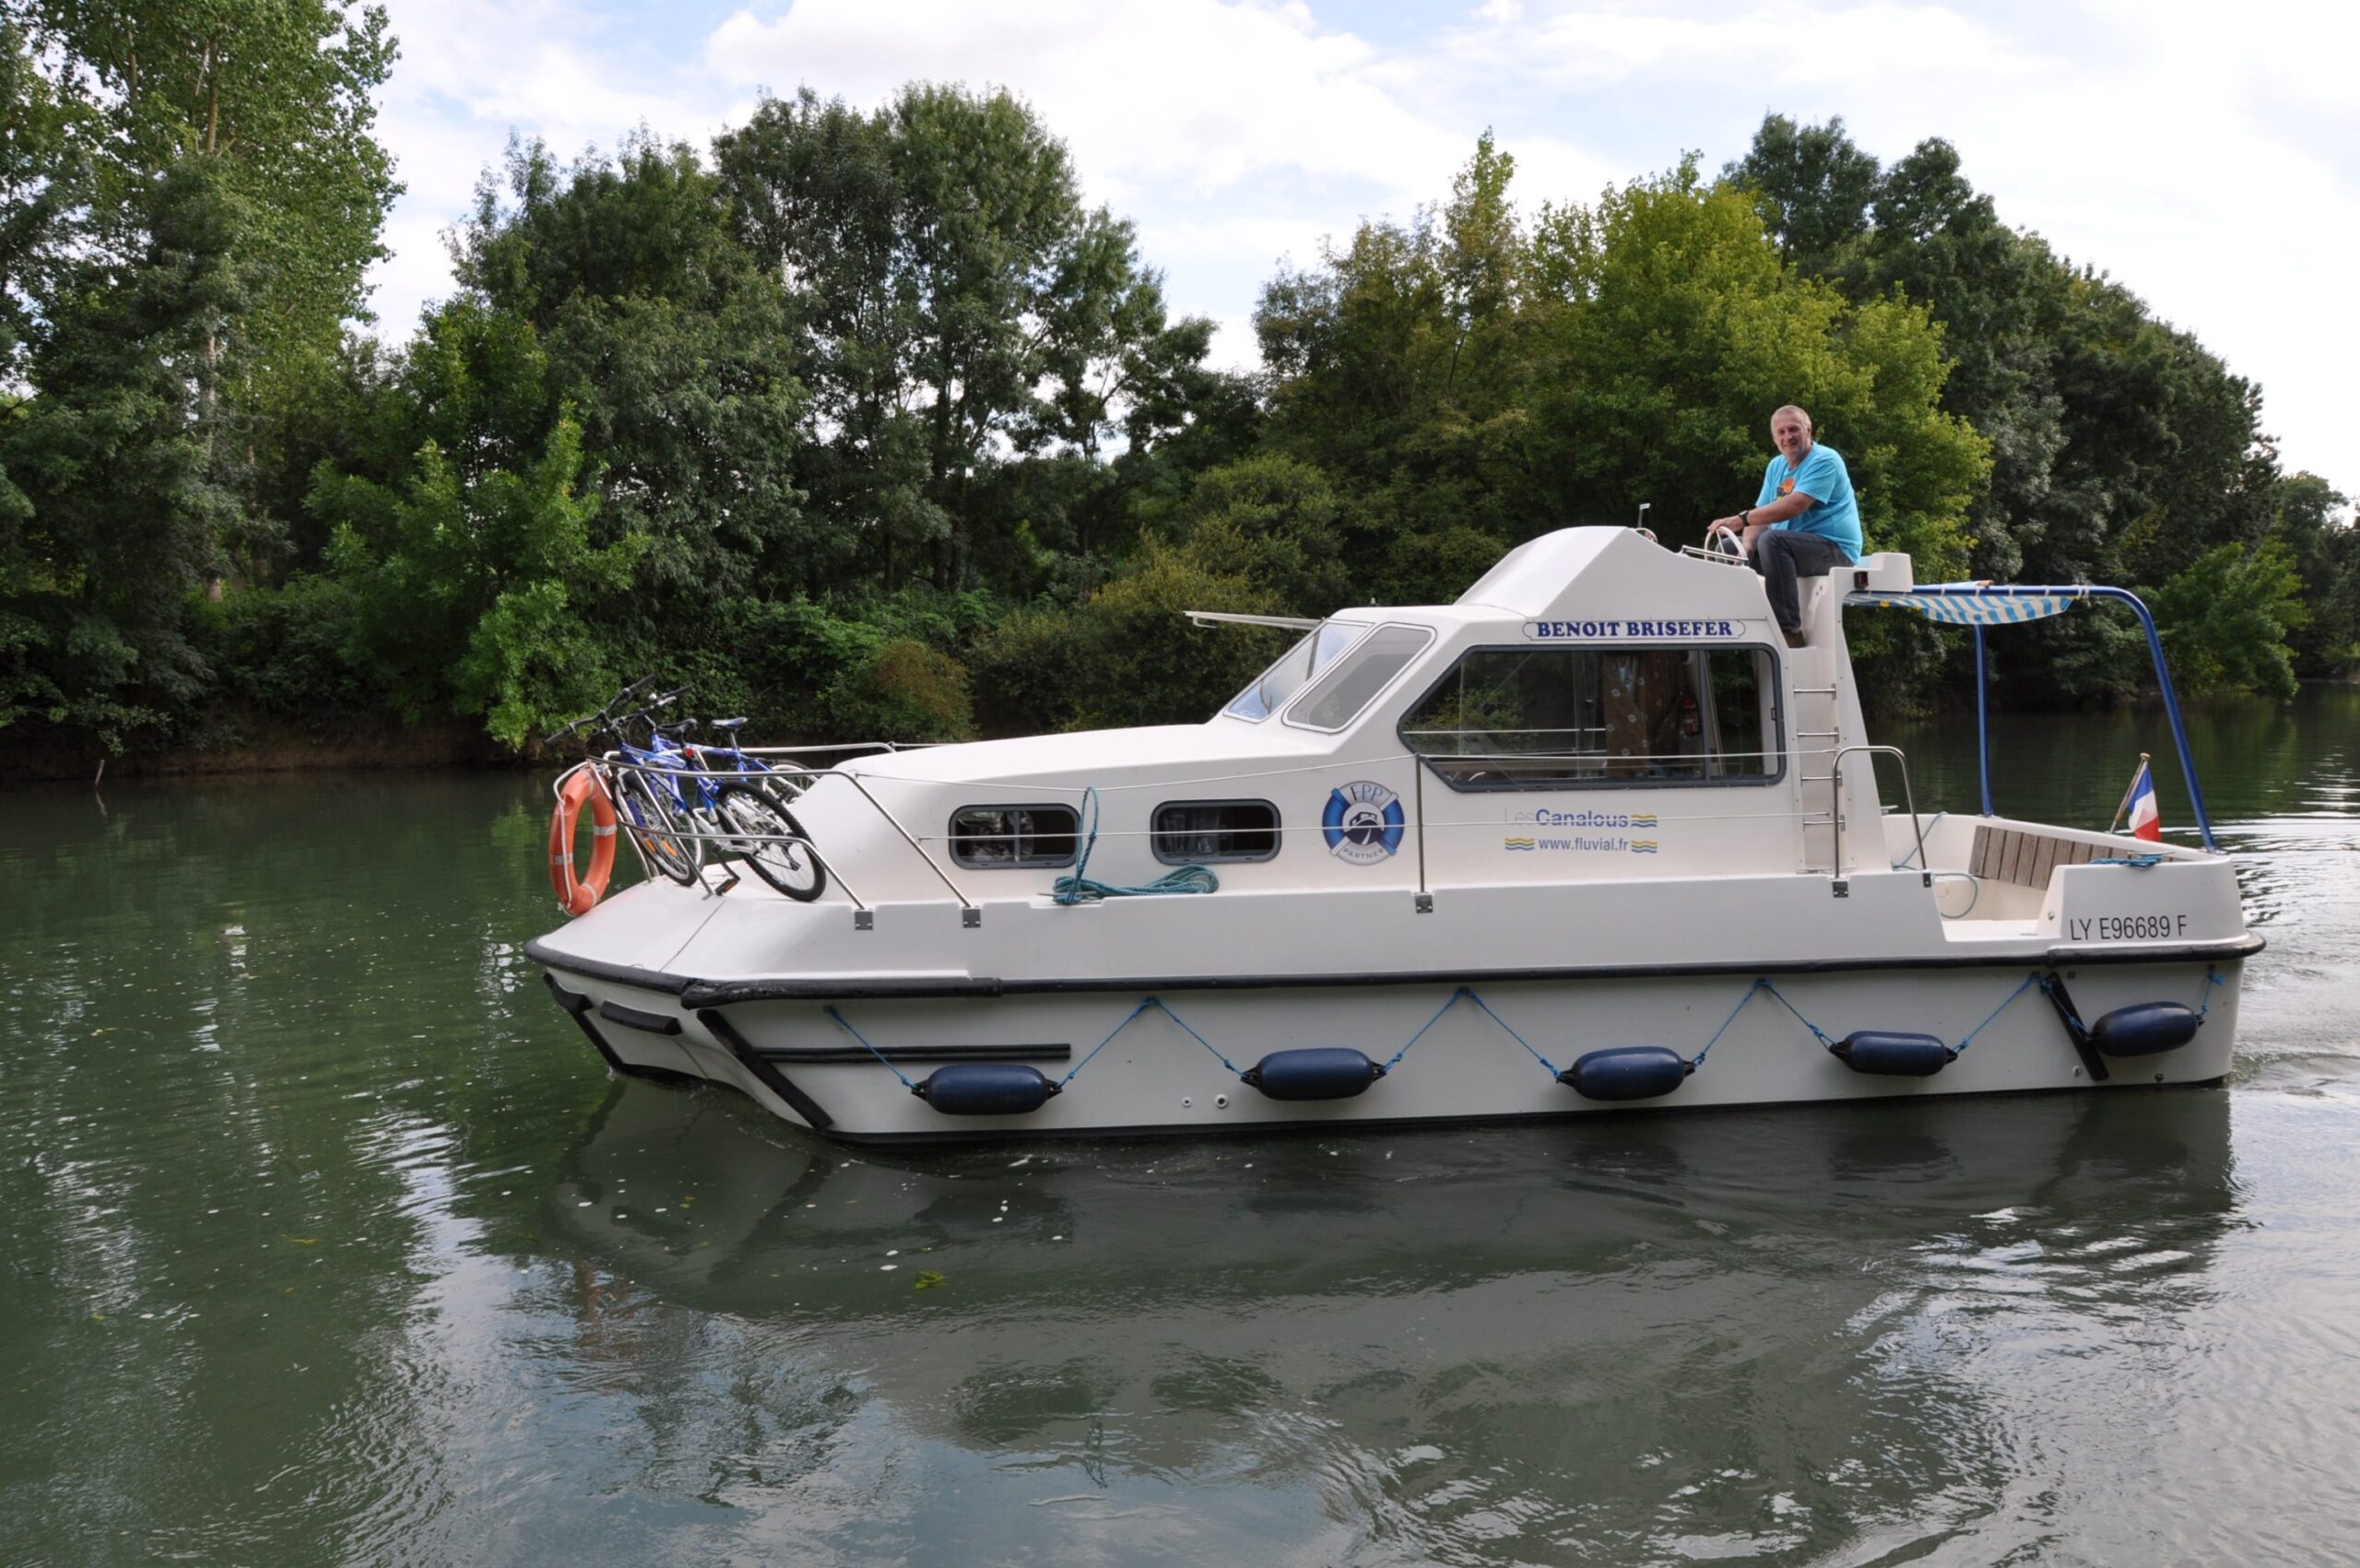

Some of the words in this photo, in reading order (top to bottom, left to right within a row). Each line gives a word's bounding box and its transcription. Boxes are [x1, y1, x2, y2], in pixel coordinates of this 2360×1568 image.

[1537, 621, 1620, 637] BENOIT
[1626, 620, 1733, 636] BRISEFER
[1539, 837, 1629, 852] www.fluvial.fr
[1342, 847, 1386, 859] PARTNER
[2070, 918, 2092, 940] LY
[2099, 915, 2171, 939] E96689
[2177, 914, 2188, 937] F
